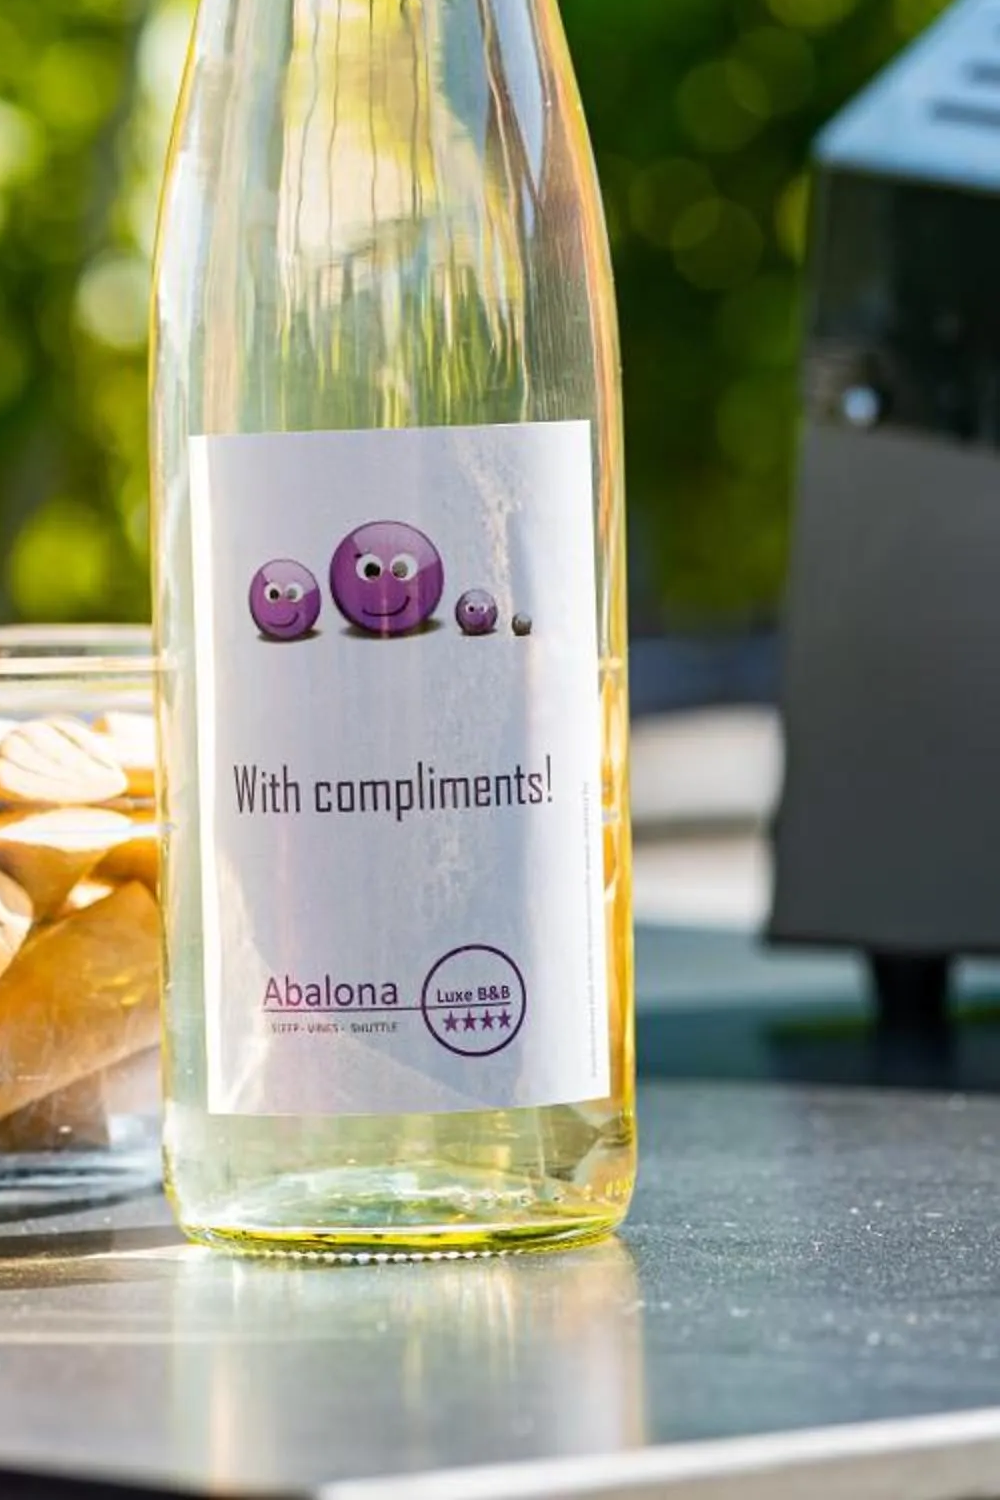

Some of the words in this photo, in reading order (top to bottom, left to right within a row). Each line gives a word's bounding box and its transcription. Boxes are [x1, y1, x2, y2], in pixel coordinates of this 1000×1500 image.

[233, 764, 302, 814] With
[315, 754, 554, 822] compliments!
[263, 974, 399, 1008] Abalona
[437, 988, 473, 1003] Luxe
[478, 985, 511, 1001] B&B
